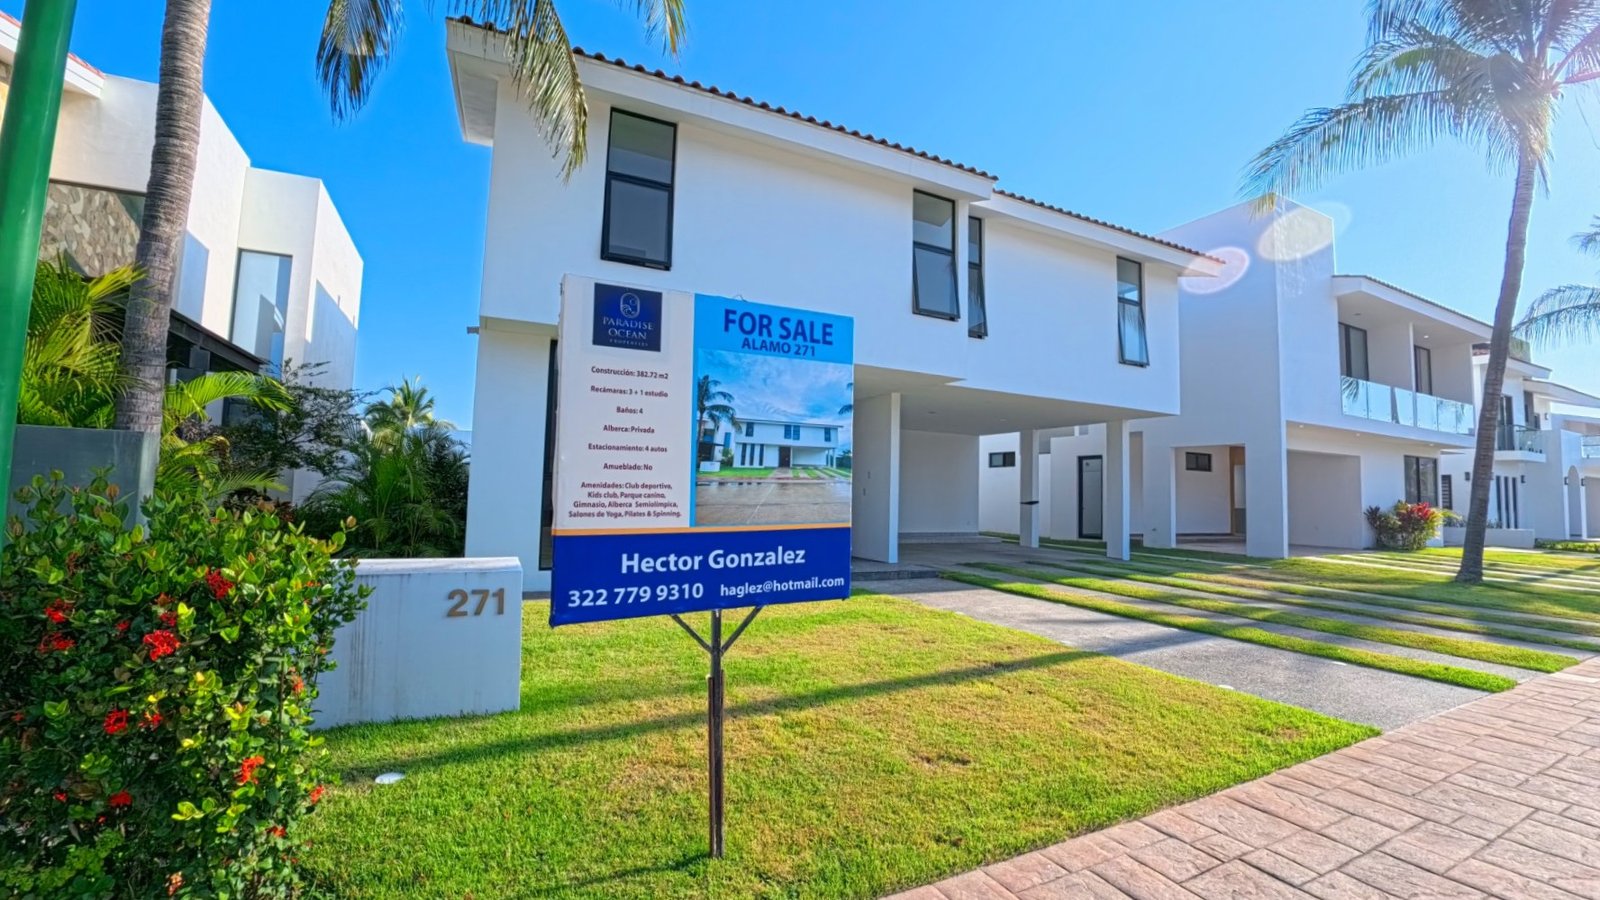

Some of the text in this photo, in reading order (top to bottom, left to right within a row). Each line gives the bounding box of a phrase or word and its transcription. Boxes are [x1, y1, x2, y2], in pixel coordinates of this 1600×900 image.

[602, 316, 654, 330] PARADISE
[723, 308, 834, 346] FOR SALE
[608, 327, 647, 340] OCEAN
[741, 337, 815, 357] ALAMO 271
[591, 366, 635, 377] Construcción:
[636, 370, 658, 379] 382.72
[590, 385, 628, 395] Recámaras:
[616, 406, 638, 414] Baños:
[603, 425, 631, 433] Alberca:
[588, 443, 644, 452] Estacionamiento:
[603, 463, 643, 471] Amueblado:
[580, 482, 673, 491] Amenidades: Club deportivo,
[603, 492, 619, 500] club,
[620, 492, 642, 501] Parque
[643, 492, 666, 500] canino,
[573, 501, 607, 509] Gimnasio,
[608, 501, 632, 509] Alberca
[606, 511, 624, 519] Yoga,
[624, 510, 646, 518] Pilates
[646, 510, 652, 518] &
[652, 510, 682, 518] Spinning.
[621, 546, 806, 574] Hector Gonzalez
[720, 576, 845, 598] haglez@hotmail.com
[567, 583, 704, 608] 322 779 9310
[446, 587, 505, 618] 271
